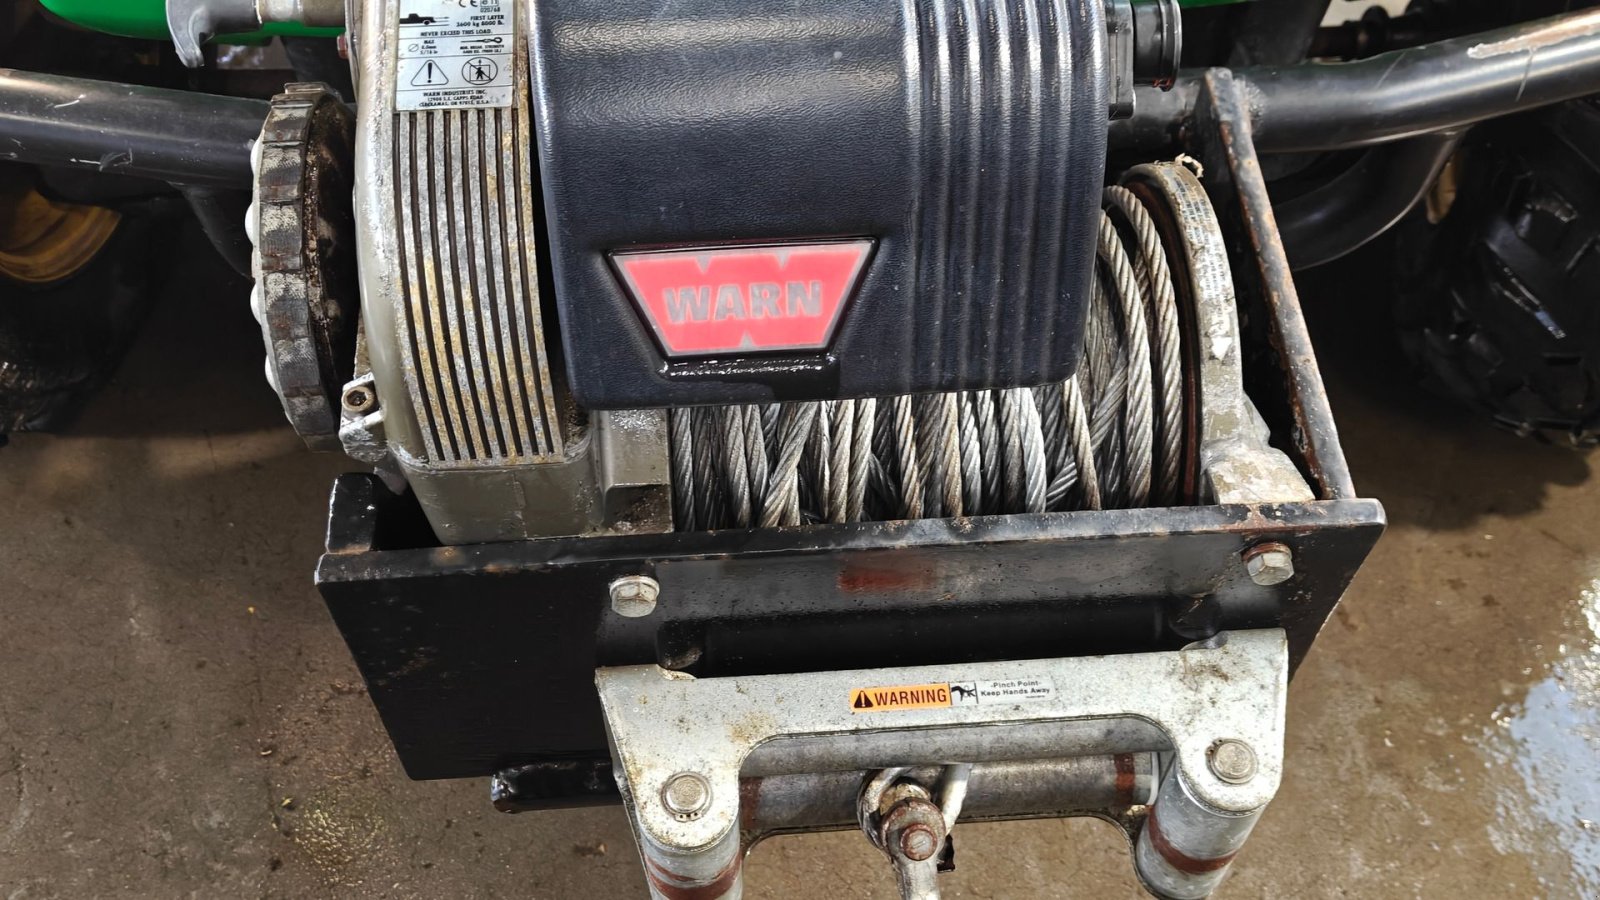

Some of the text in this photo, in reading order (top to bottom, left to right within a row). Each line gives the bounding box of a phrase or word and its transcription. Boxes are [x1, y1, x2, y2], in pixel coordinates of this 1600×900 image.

[664, 281, 822, 323] WARN
[874, 688, 947, 706] WARNING
[1030, 687, 1050, 695] Away
